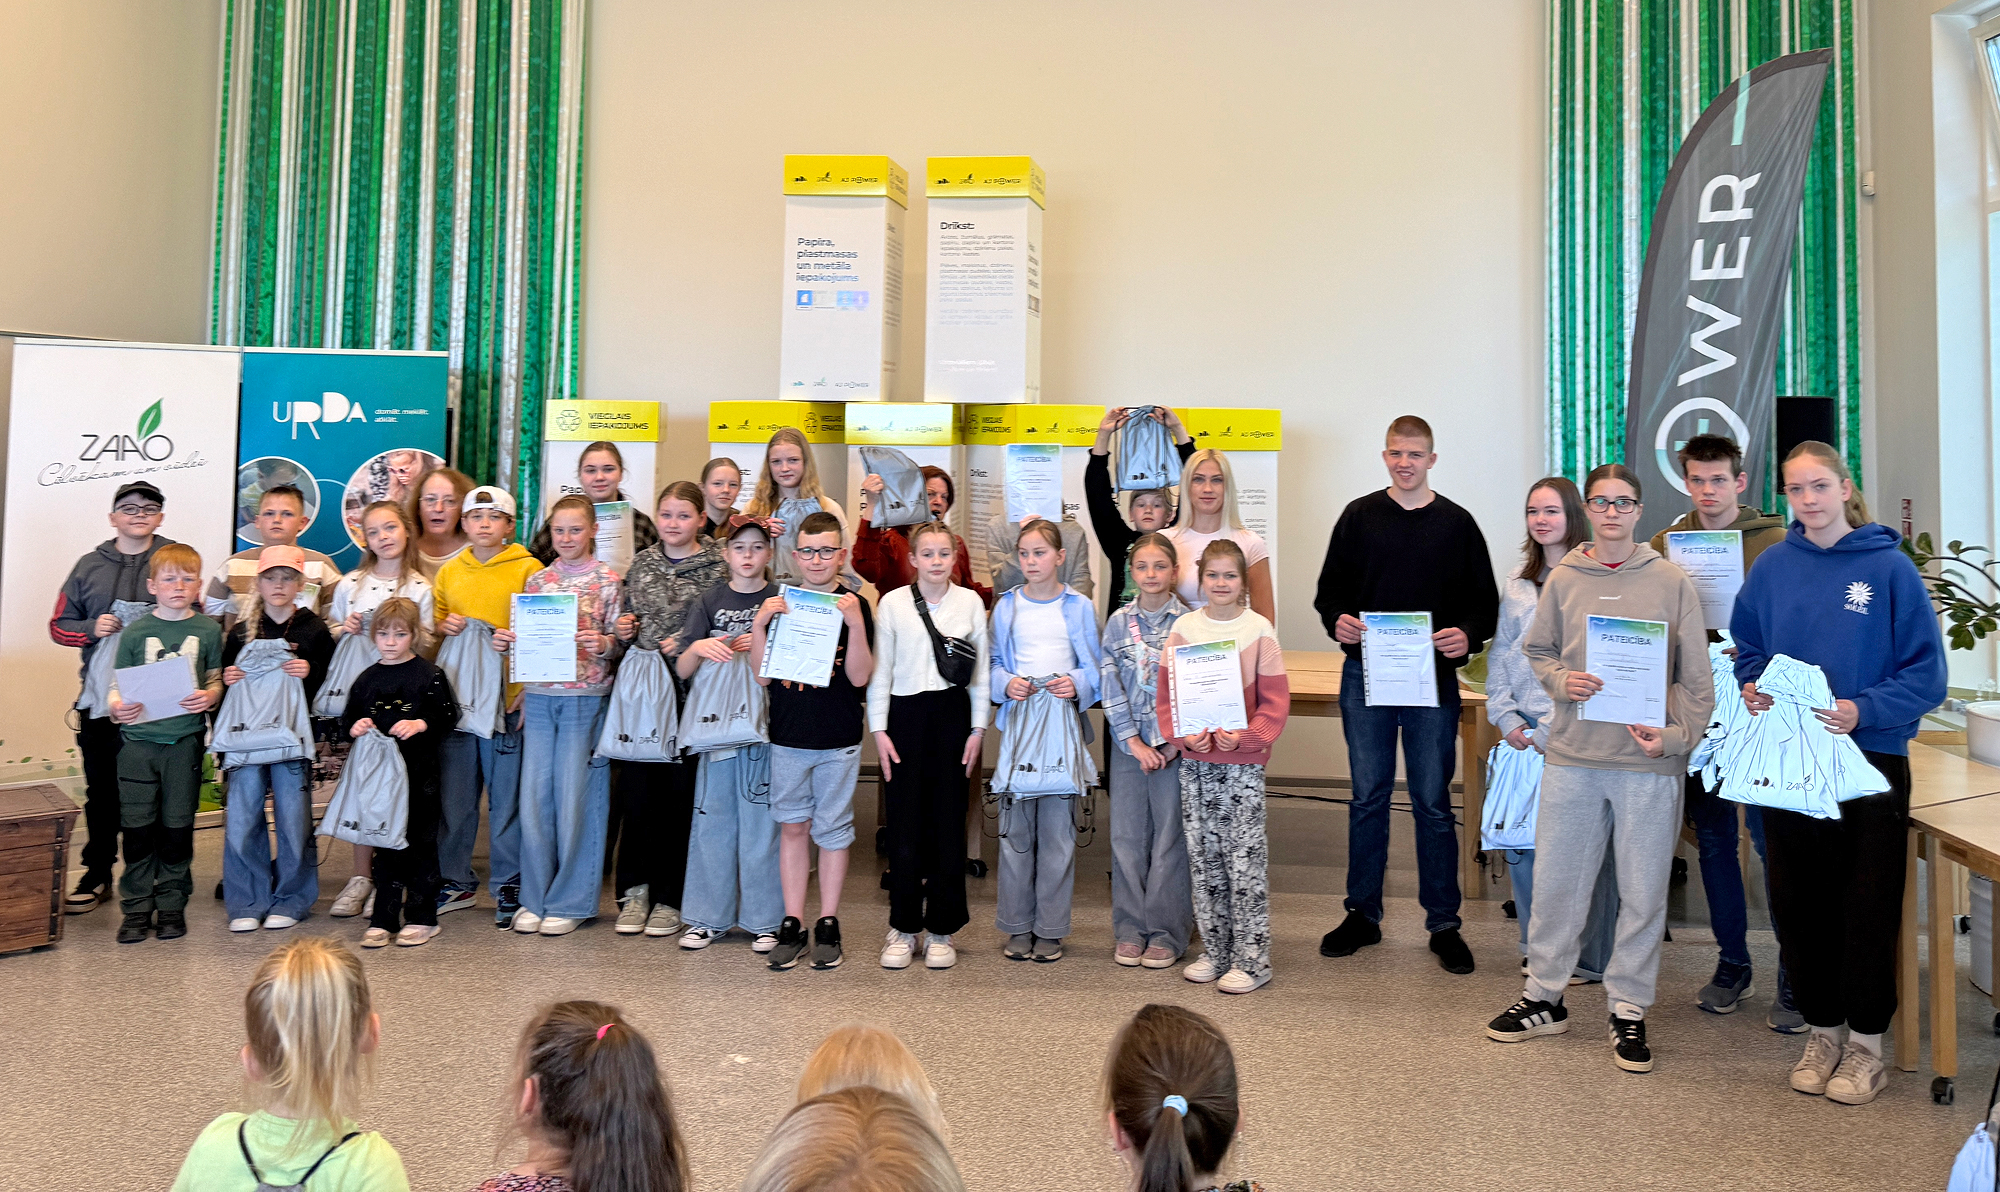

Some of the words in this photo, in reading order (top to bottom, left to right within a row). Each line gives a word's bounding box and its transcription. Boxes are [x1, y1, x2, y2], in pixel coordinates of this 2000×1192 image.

[796, 249, 859, 260] plastmasas
[796, 262, 812, 270] un
[1655, 172, 1762, 497] OWER
[272, 391, 368, 440] URDA
[79, 434, 175, 462] ZAAO
[1376, 627, 1420, 636] PATEICĪBA
[1600, 633, 1653, 646] PATEICĪBA
[1186, 653, 1228, 665] PATEICĪBA
[1786, 781, 1815, 792] ZAAO
